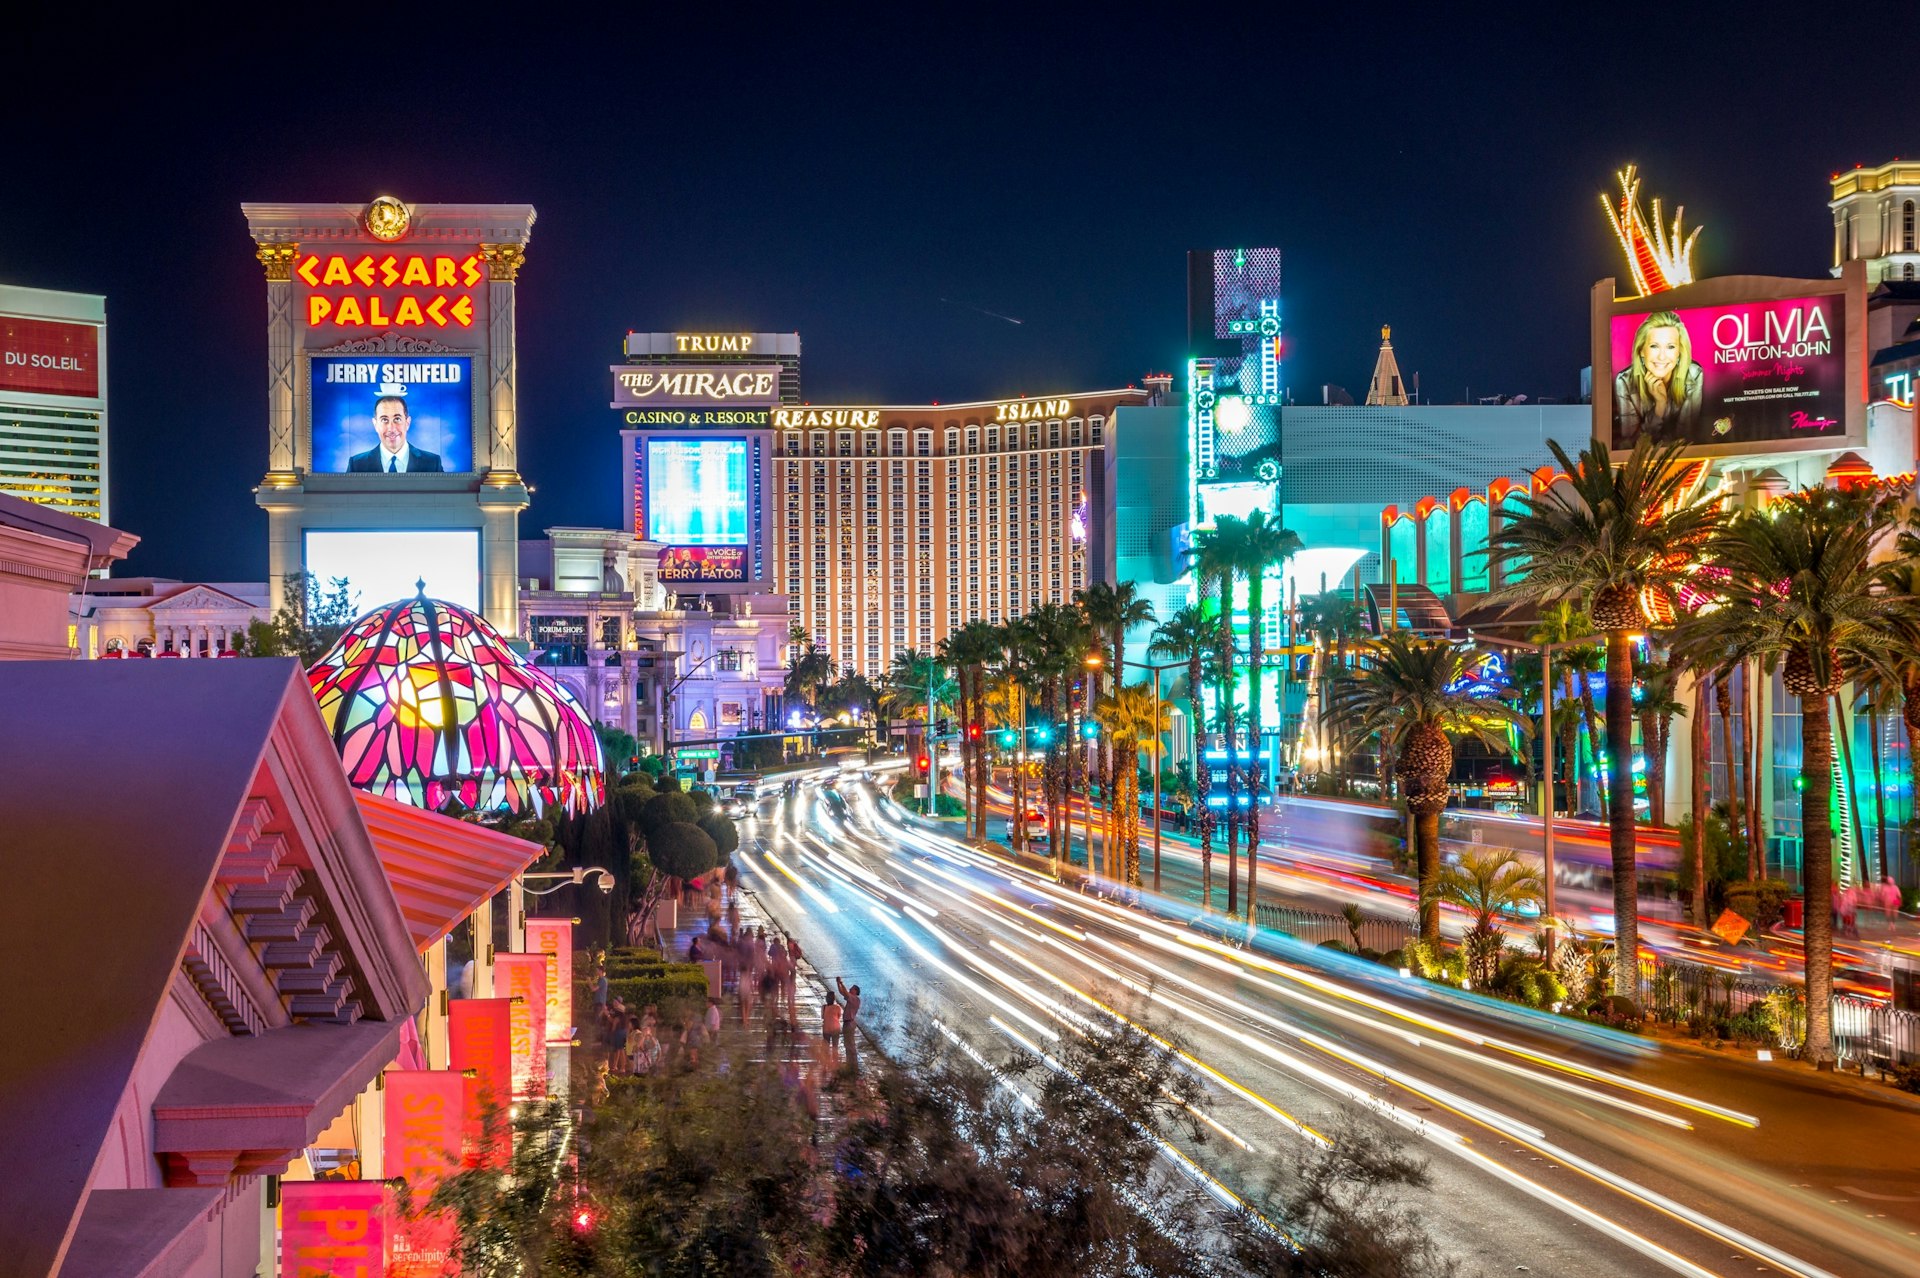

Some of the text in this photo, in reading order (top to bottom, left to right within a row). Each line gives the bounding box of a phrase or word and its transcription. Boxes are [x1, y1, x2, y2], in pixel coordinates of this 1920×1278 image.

[297, 255, 482, 288] CAESARS
[309, 295, 473, 327] PALACE
[1712, 306, 1831, 349] OLIVIA
[676, 335, 752, 352] TRUMP
[1714, 341, 1831, 364] NEWTON-JOHN
[5, 351, 82, 371] DU SOLEIL
[1776, 361, 1805, 381] Nights
[326, 363, 461, 384] JERRY SEINFELD
[619, 373, 774, 399] THE MIRAGE
[626, 411, 768, 425] CASINO & RESORT
[771, 400, 1070, 428] REASURE ISLAND
[658, 569, 742, 579] TERRY FATOR
